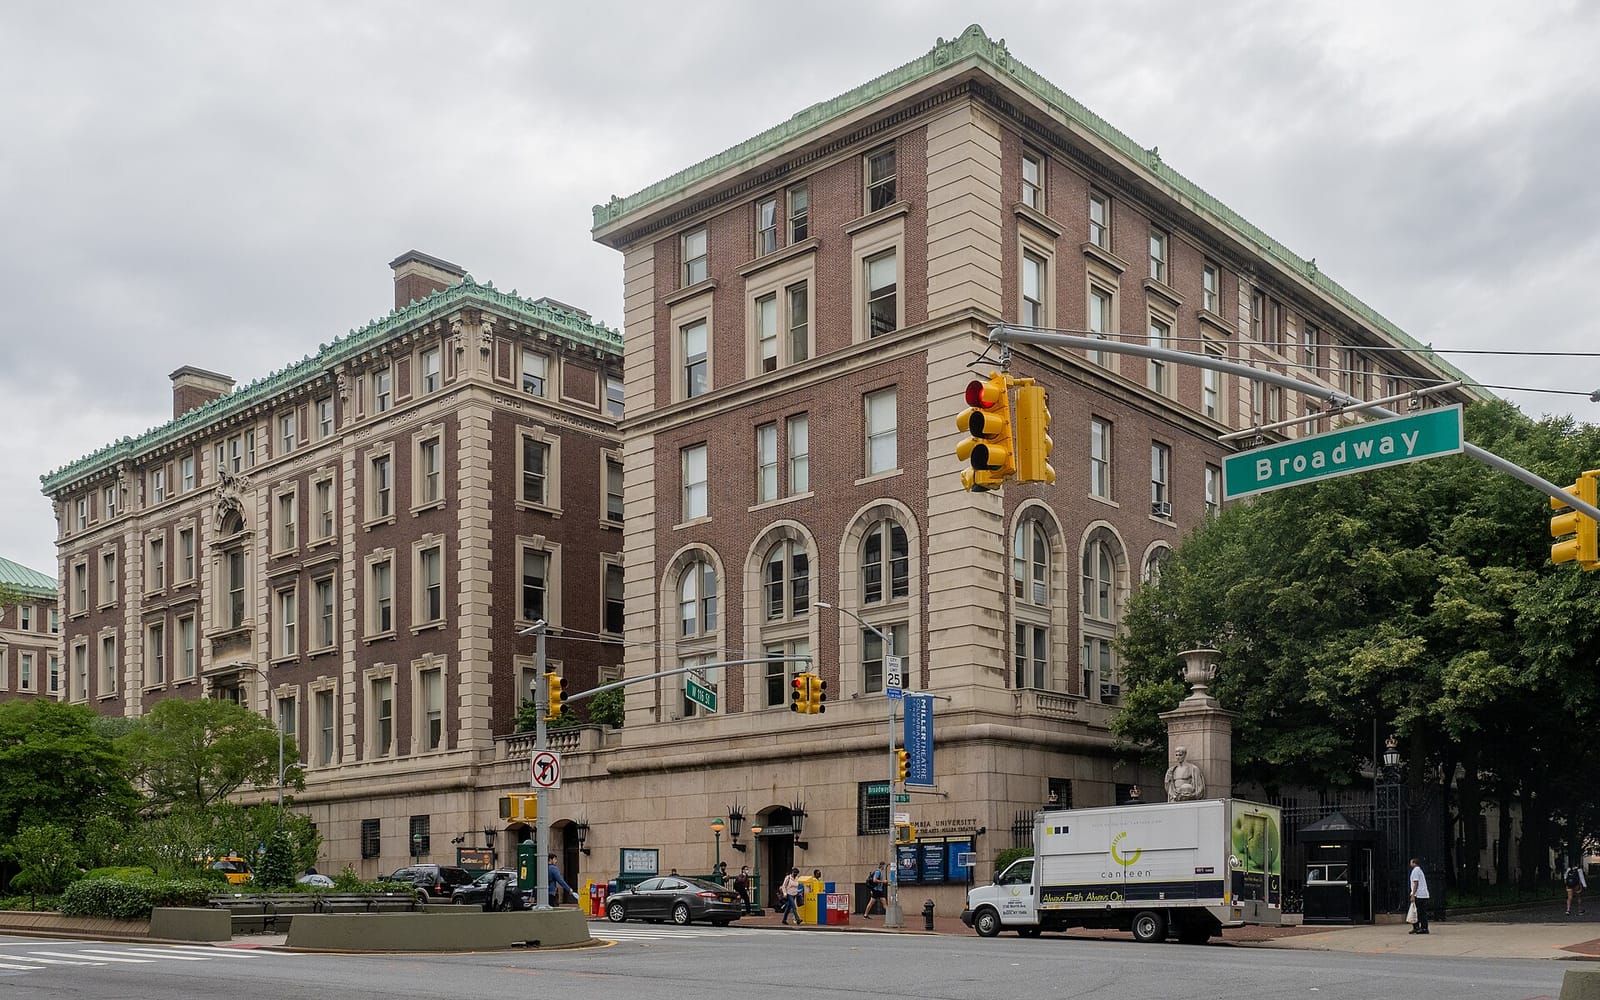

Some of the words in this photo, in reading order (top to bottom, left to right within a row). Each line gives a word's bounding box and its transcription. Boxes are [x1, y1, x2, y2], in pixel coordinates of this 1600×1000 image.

[1255, 430, 1420, 482] Broadway
[888, 673, 900, 686] 25
[936, 818, 977, 826] UNIVERSITY
[1101, 869, 1151, 879] canteen
[1042, 893, 1065, 903] Always
[1085, 891, 1109, 902] Always
